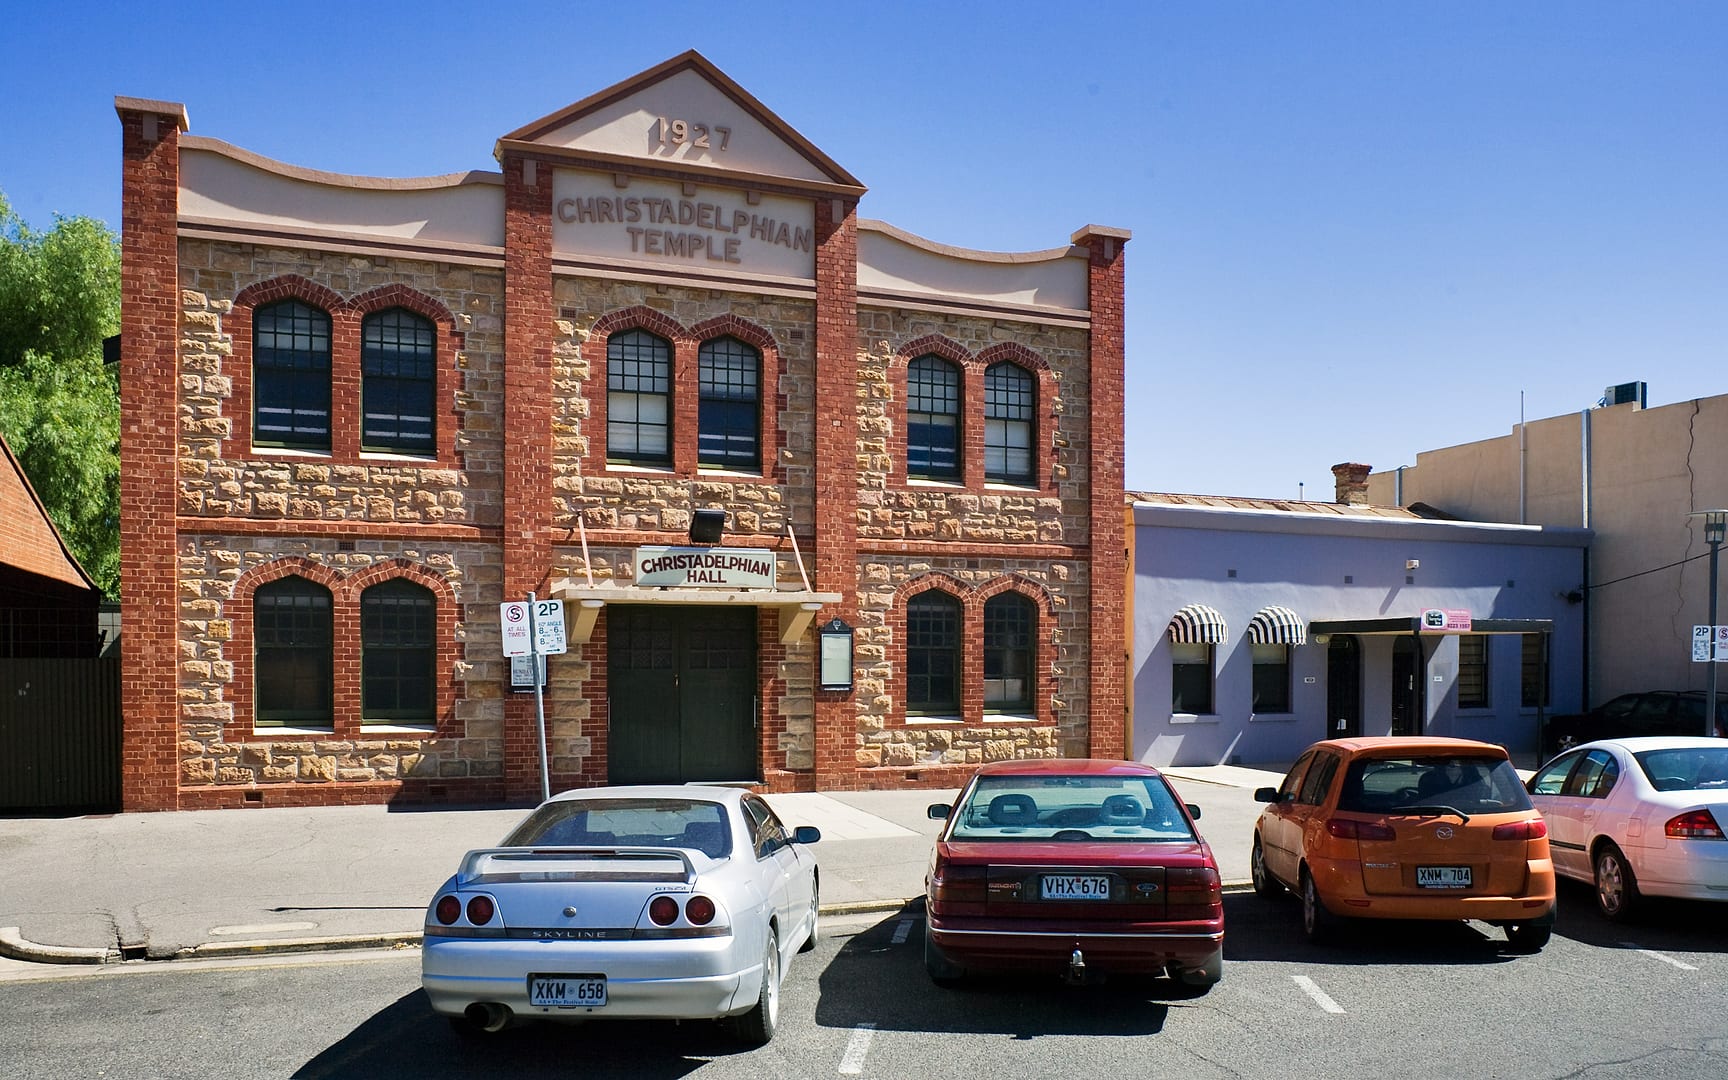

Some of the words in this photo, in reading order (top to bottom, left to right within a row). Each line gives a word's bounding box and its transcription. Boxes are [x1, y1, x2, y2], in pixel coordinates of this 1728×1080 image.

[657, 116, 732, 150] 1927
[556, 196, 813, 253] CHRISTADELPHIAN
[626, 225, 742, 263] TEMPLE
[641, 554, 770, 577] CHRISTADELPHIAN
[687, 570, 727, 583] HALL
[538, 602, 559, 616] 2P
[1695, 627, 1709, 636] 2P
[1420, 869, 1442, 880] XNM
[1451, 869, 1470, 880] 704
[1045, 878, 1075, 894] VHX
[1081, 879, 1107, 894] 676
[535, 982, 566, 999] XKM
[578, 983, 604, 999] 658
